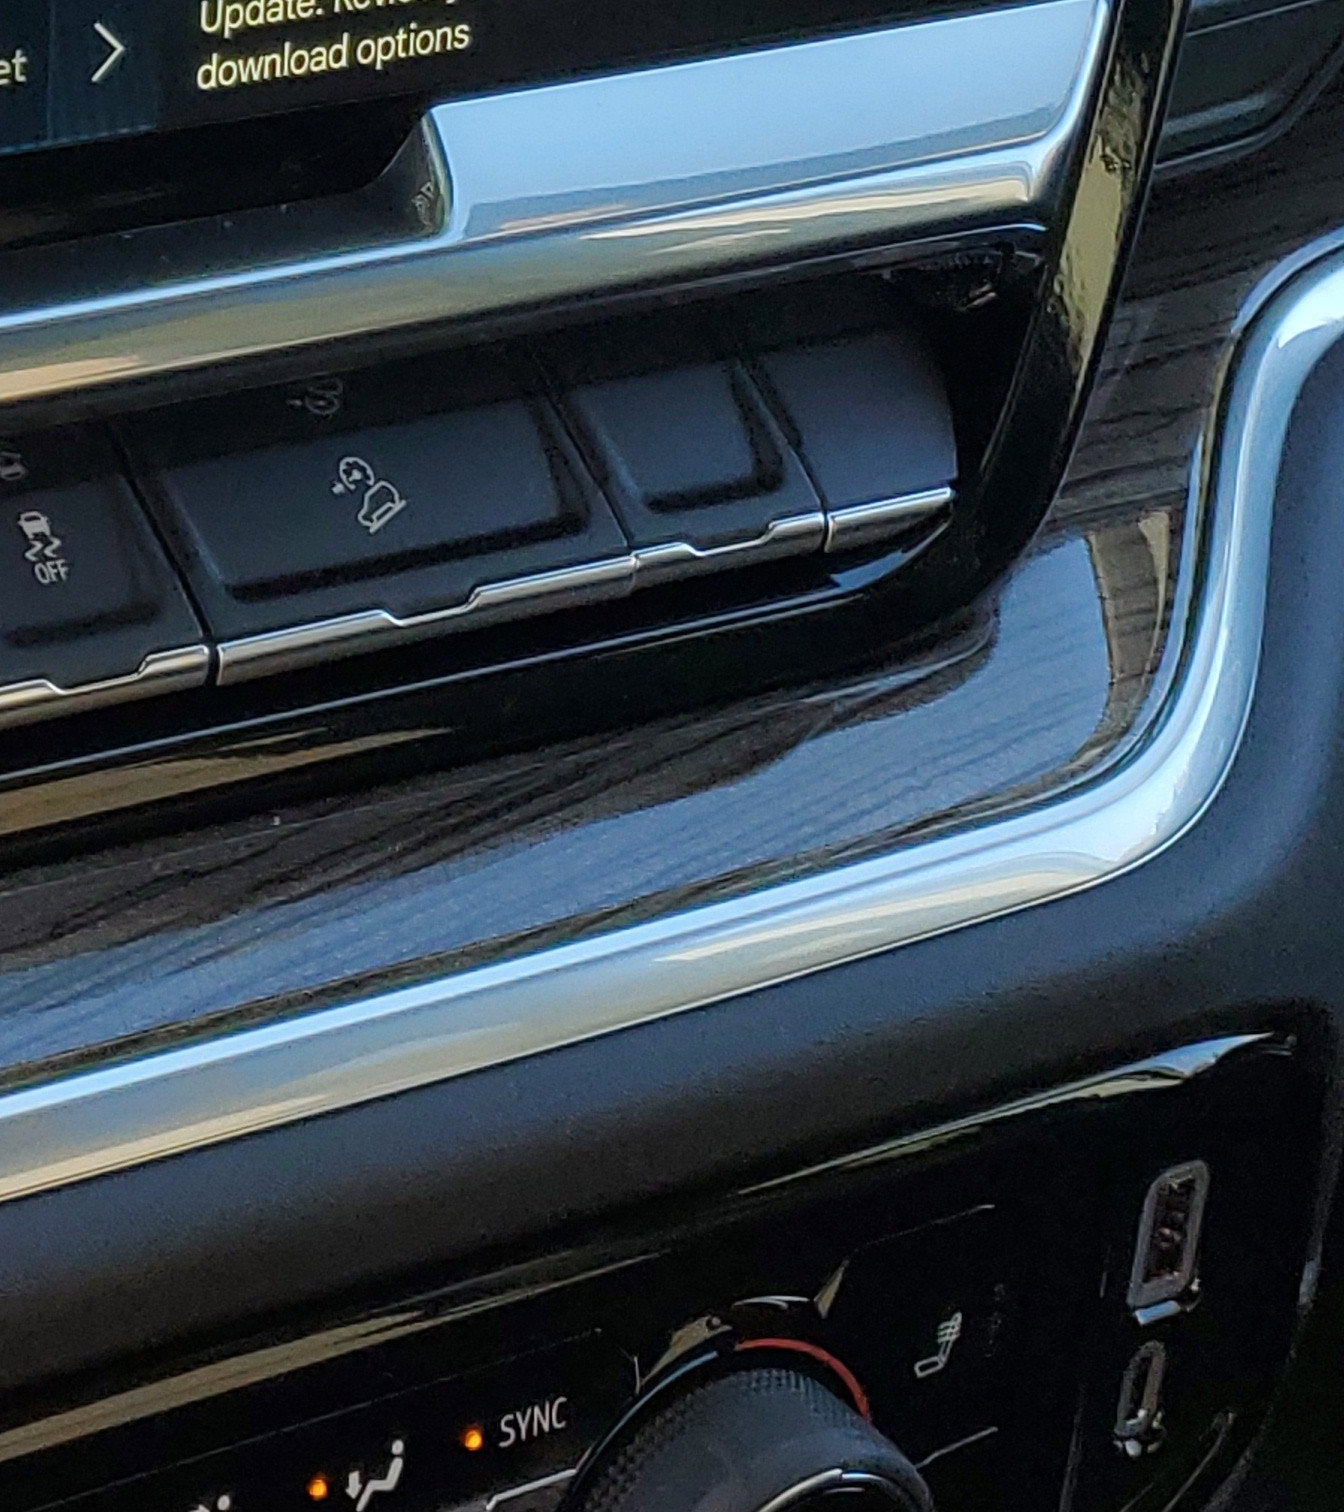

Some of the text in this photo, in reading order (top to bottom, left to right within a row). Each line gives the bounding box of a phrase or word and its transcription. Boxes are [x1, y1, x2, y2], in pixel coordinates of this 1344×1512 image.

[196, 22, 471, 90] download options
[34, 558, 70, 585] OFF
[498, 1396, 568, 1448] SYNC
